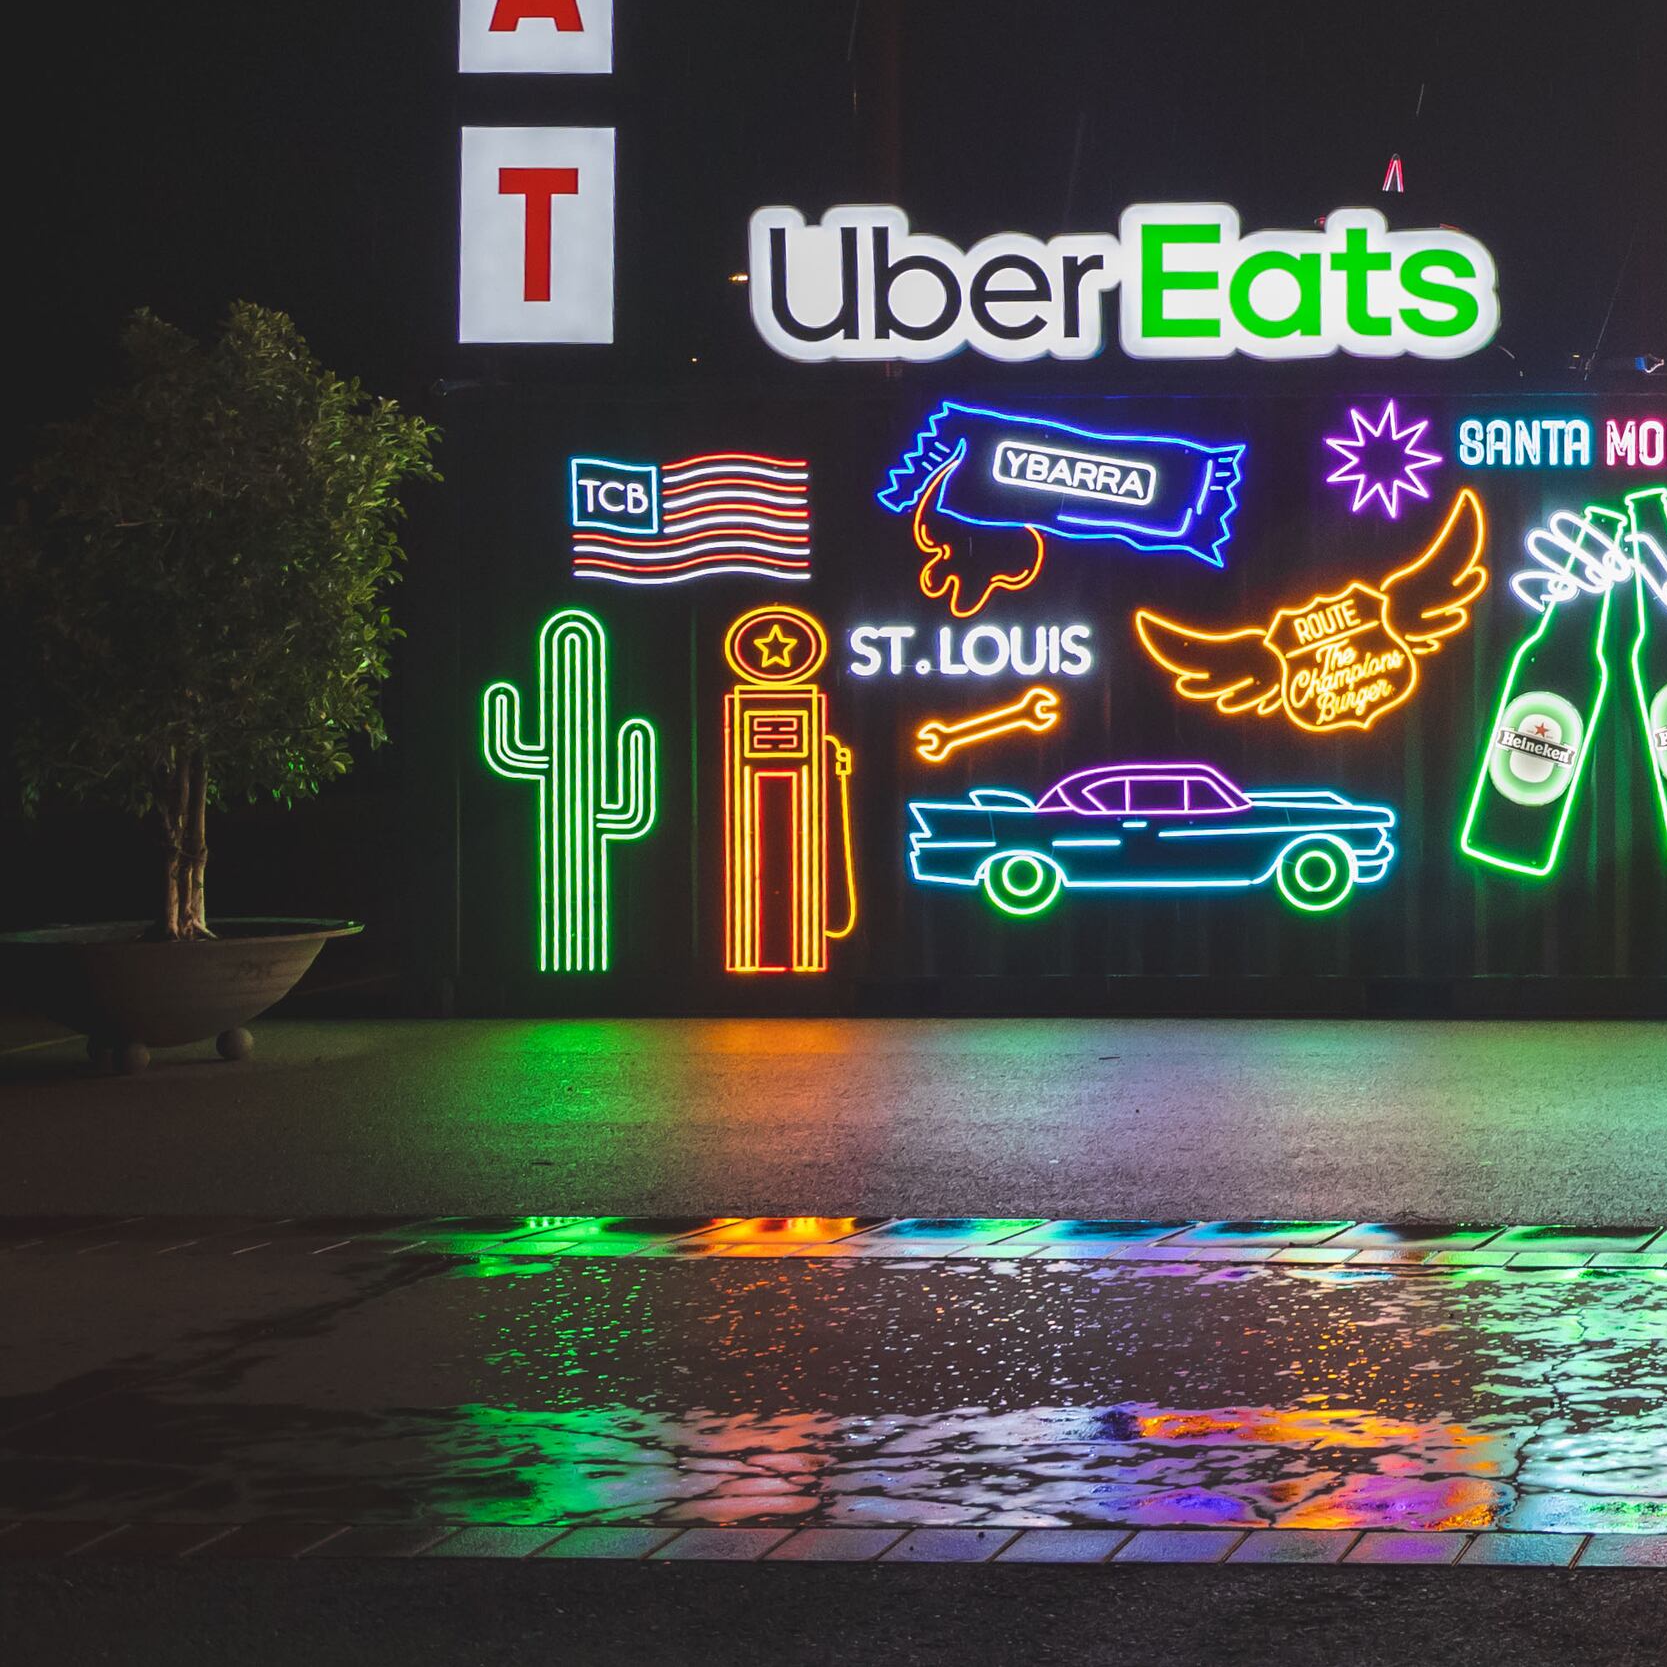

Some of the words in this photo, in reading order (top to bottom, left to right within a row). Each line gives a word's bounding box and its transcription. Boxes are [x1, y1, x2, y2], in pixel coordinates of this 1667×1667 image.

[769, 226, 1103, 342] Uber
[1141, 224, 1480, 340] Eats
[1459, 418, 1590, 466] SANTA
[578, 478, 649, 516] TCB
[1006, 449, 1145, 499] YBARRA
[1293, 599, 1361, 645] ROUTE
[1290, 649, 1406, 708] Champions
[1315, 638, 1358, 679] The
[1315, 679, 1393, 726] Burger
[1500, 729, 1573, 765] Heineken
